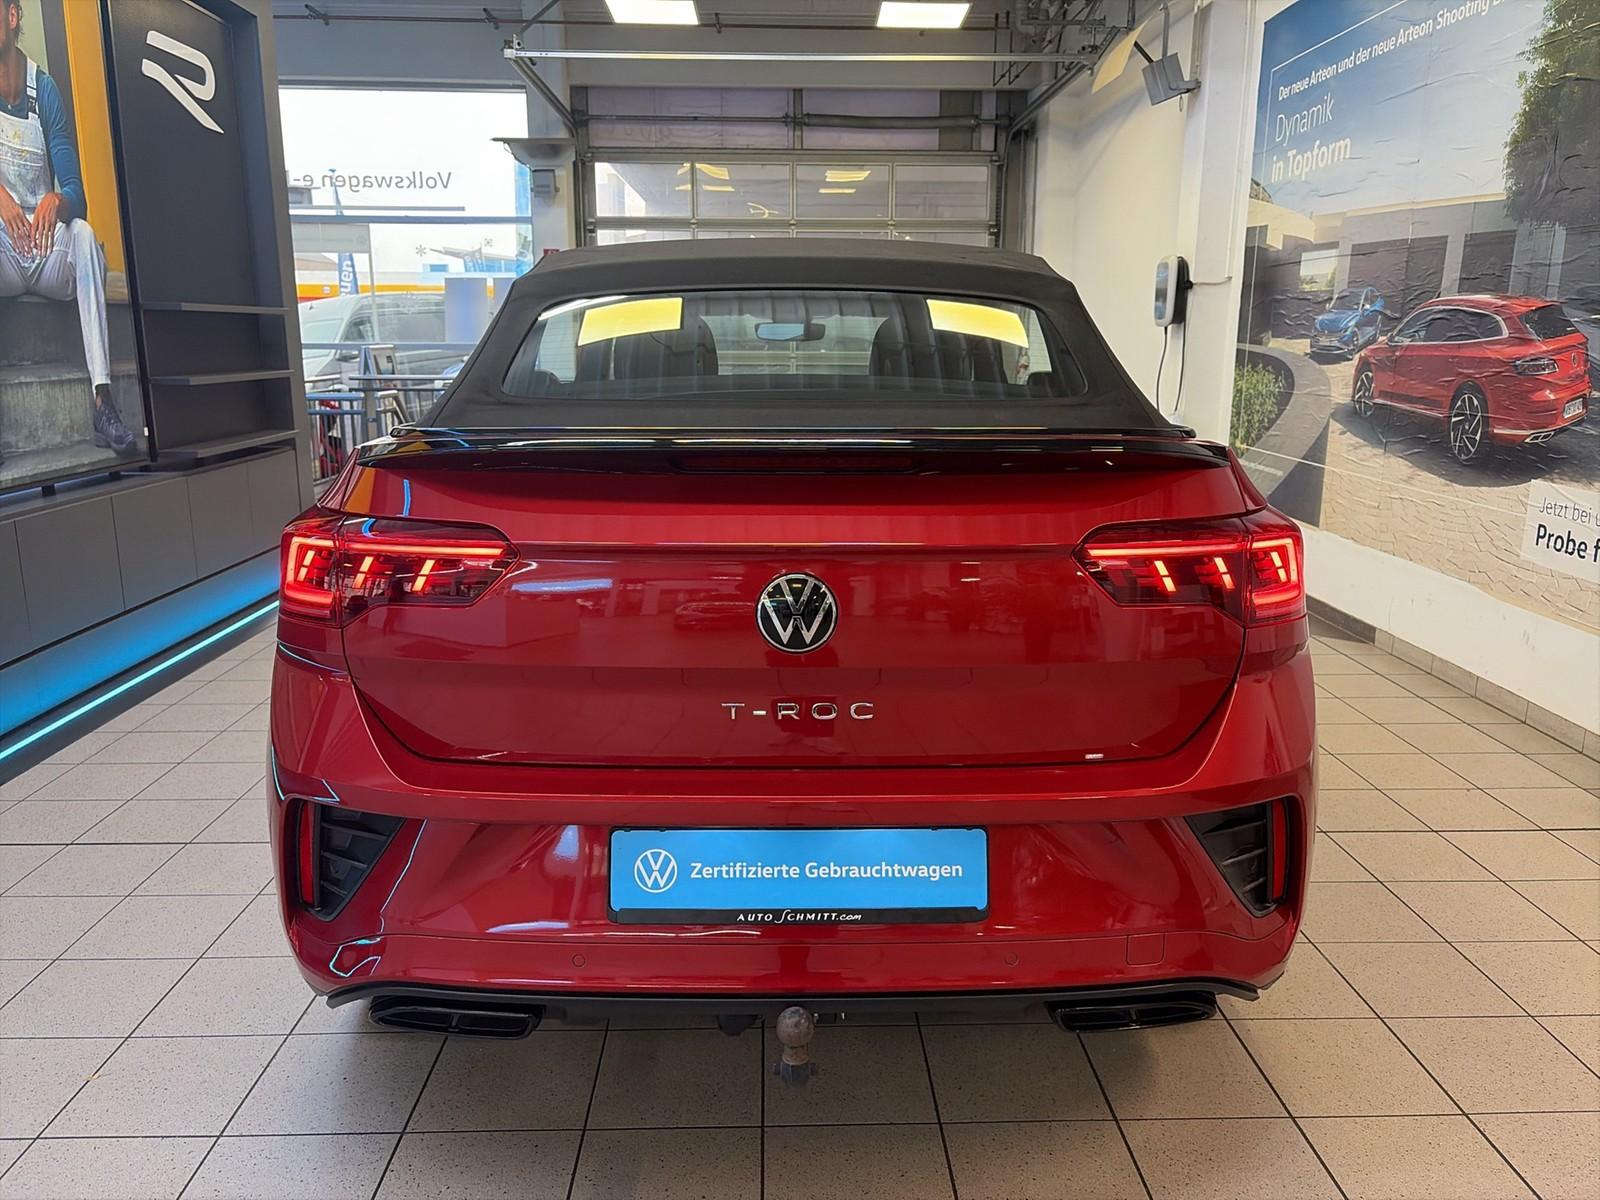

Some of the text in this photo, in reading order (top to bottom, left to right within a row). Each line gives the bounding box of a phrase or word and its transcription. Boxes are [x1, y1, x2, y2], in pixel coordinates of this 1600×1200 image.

[1279, 0, 1490, 100] Der neue Arteon und der neue Arteon Shooting
[1275, 92, 1334, 147] Dynamik
[1271, 137, 1352, 183] in Topform
[1539, 497, 1569, 519] Jetzt
[1571, 503, 1592, 524] bei
[1535, 523, 1588, 559] Probe
[721, 702, 874, 720] T-ROC
[690, 862, 963, 881] Zertifizierte Gebrauchtwagen
[736, 913, 773, 921] AUTO
